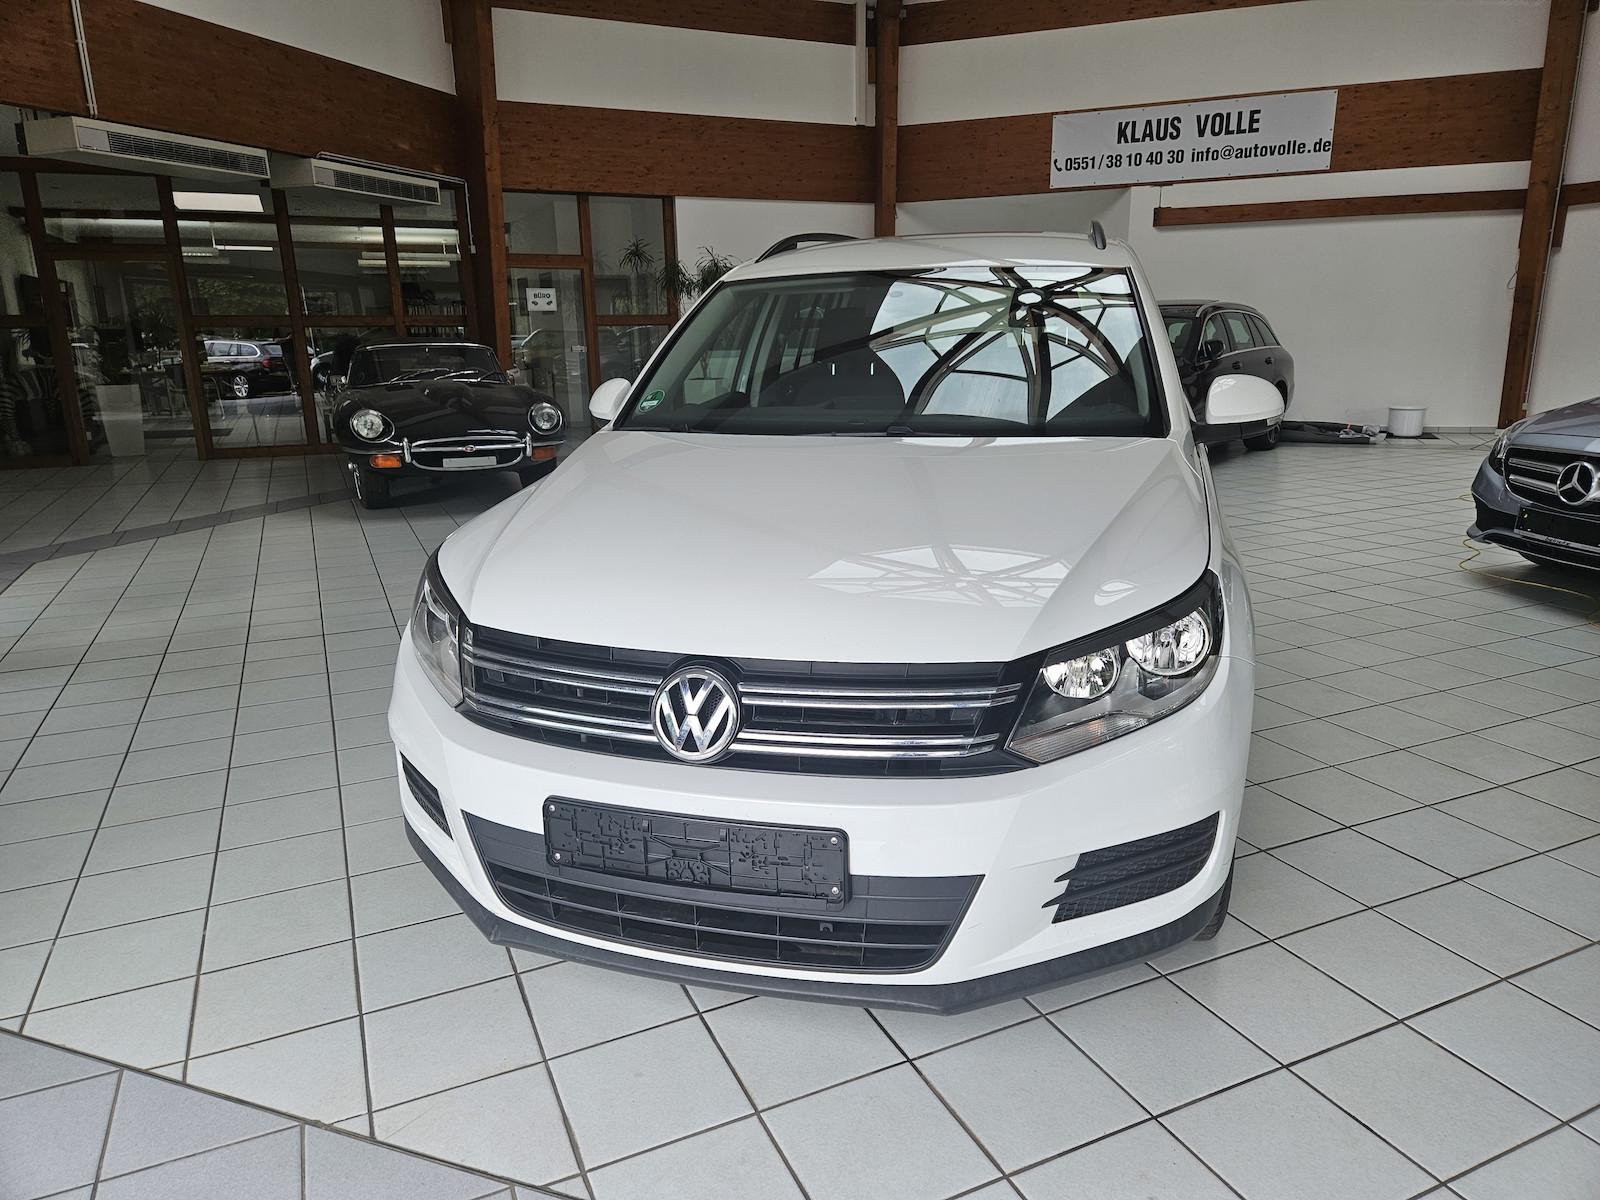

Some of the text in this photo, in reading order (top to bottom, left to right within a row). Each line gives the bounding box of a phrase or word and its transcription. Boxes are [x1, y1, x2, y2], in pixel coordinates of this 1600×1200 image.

[1117, 109, 1261, 144] KLAUS VOLLE
[1126, 153, 1142, 167] 10
[1146, 151, 1163, 165] 40
[1167, 149, 1184, 164] 30
[1191, 138, 1331, 163] info@autovolle.de
[655, 673, 735, 755] VW
